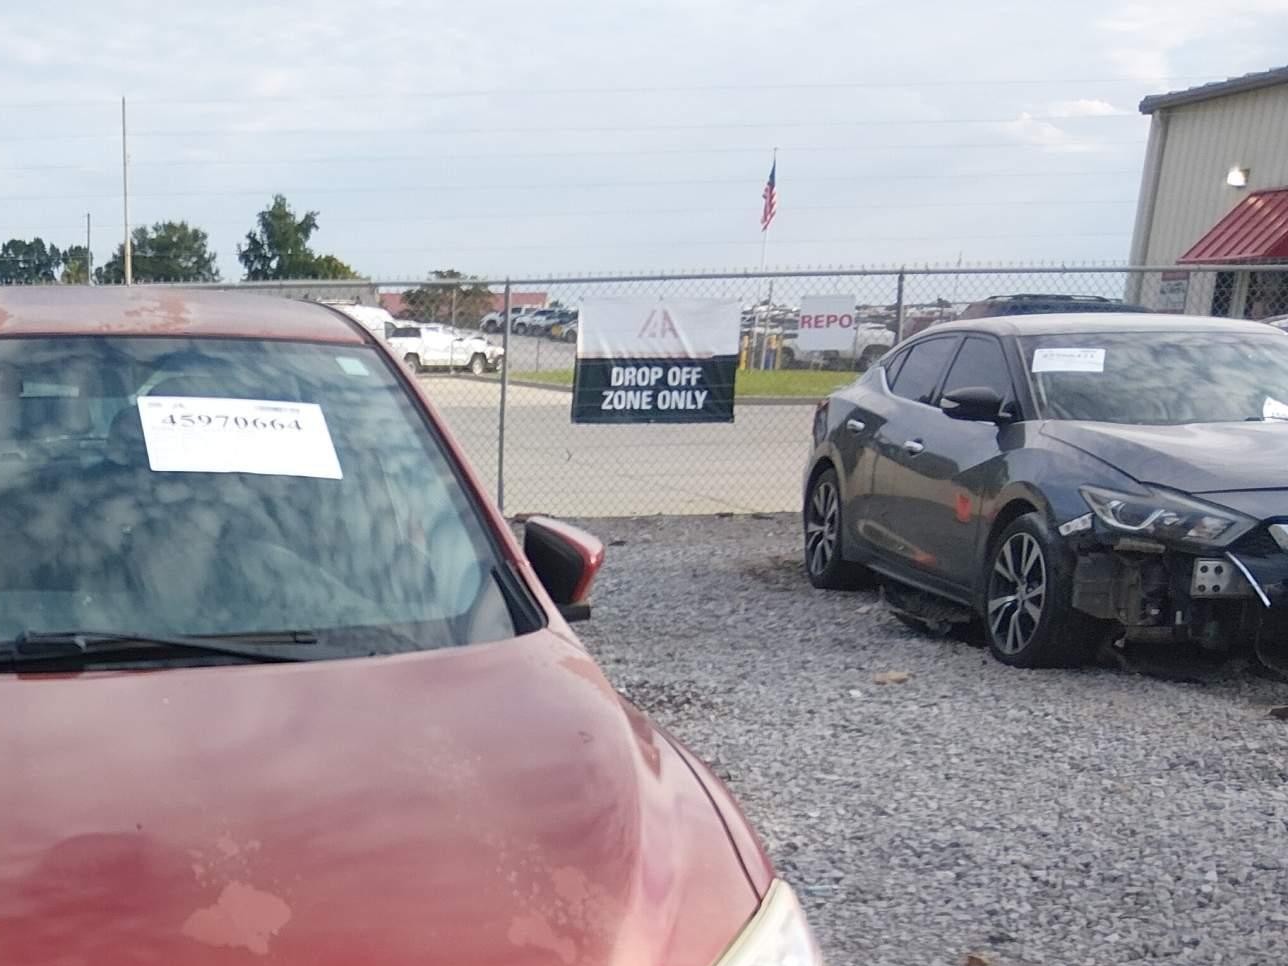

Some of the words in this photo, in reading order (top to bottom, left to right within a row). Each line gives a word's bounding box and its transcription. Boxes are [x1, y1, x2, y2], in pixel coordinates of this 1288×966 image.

[800, 313, 853, 329] REPO
[610, 366, 663, 387] DROP
[667, 366, 702, 386] OFF
[601, 391, 654, 411] ZONE
[657, 391, 708, 410] ONLY
[162, 414, 303, 431] 45970664
